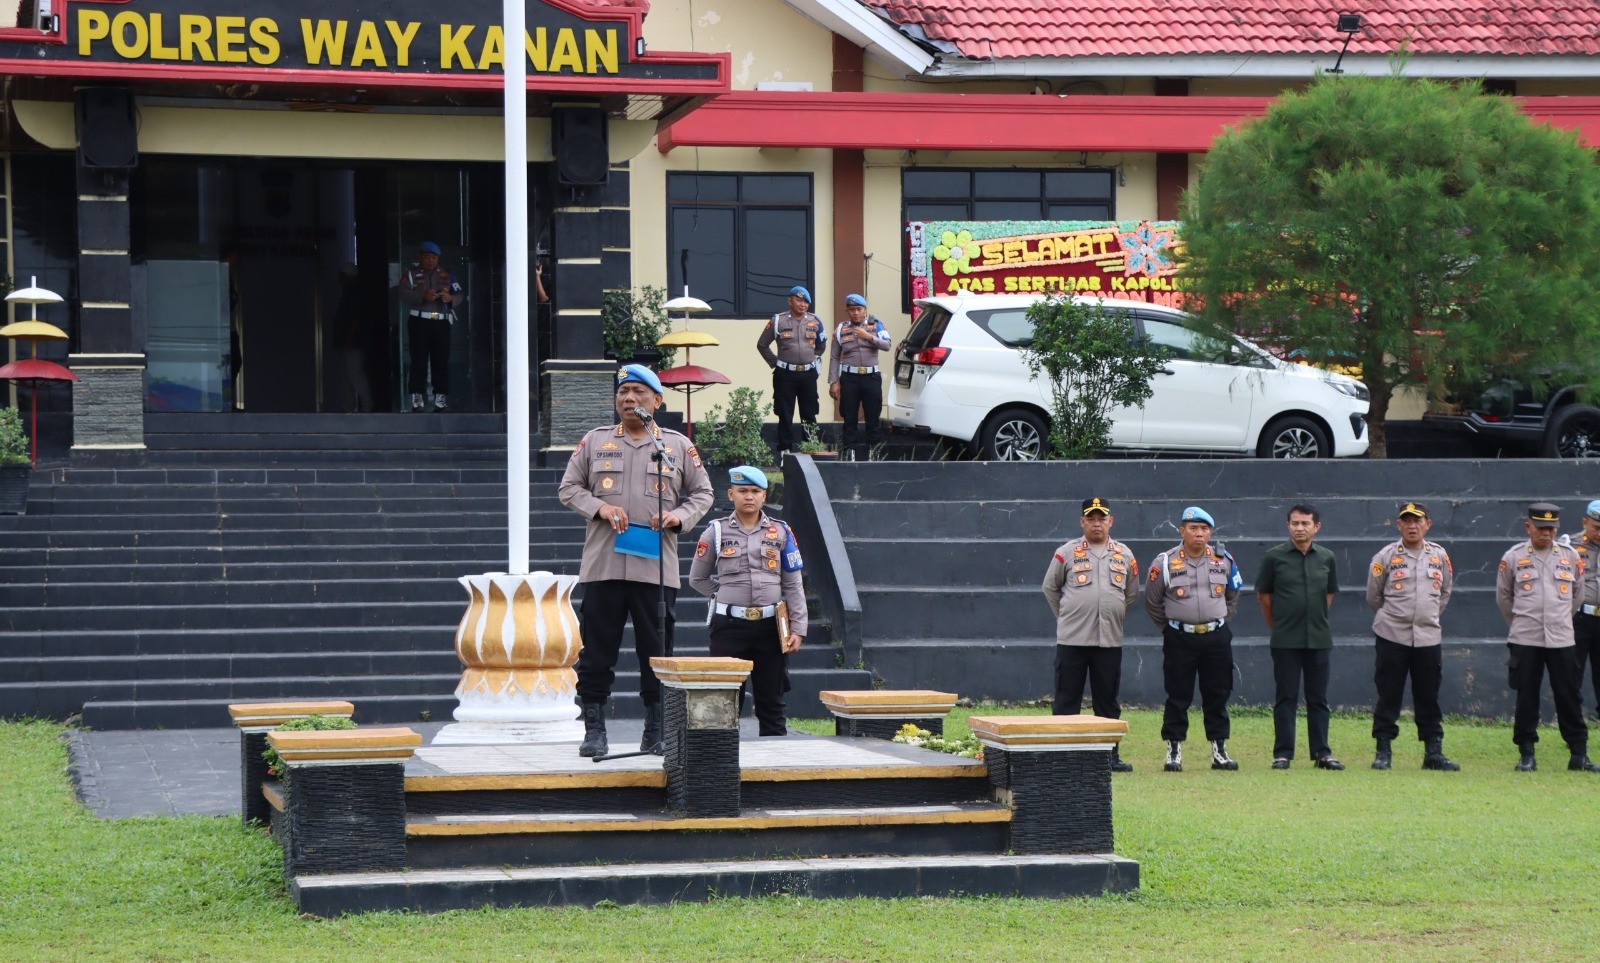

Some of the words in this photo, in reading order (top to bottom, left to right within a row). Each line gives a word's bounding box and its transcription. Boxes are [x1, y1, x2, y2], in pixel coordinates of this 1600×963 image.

[77, 8, 281, 65] POLRES
[300, 18, 422, 67] WAY
[440, 23, 619, 74] KANAN
[982, 233, 1114, 266] SELAMAT
[948, 277, 995, 292] ATAS
[1004, 276, 1101, 293] SERTIJAB
